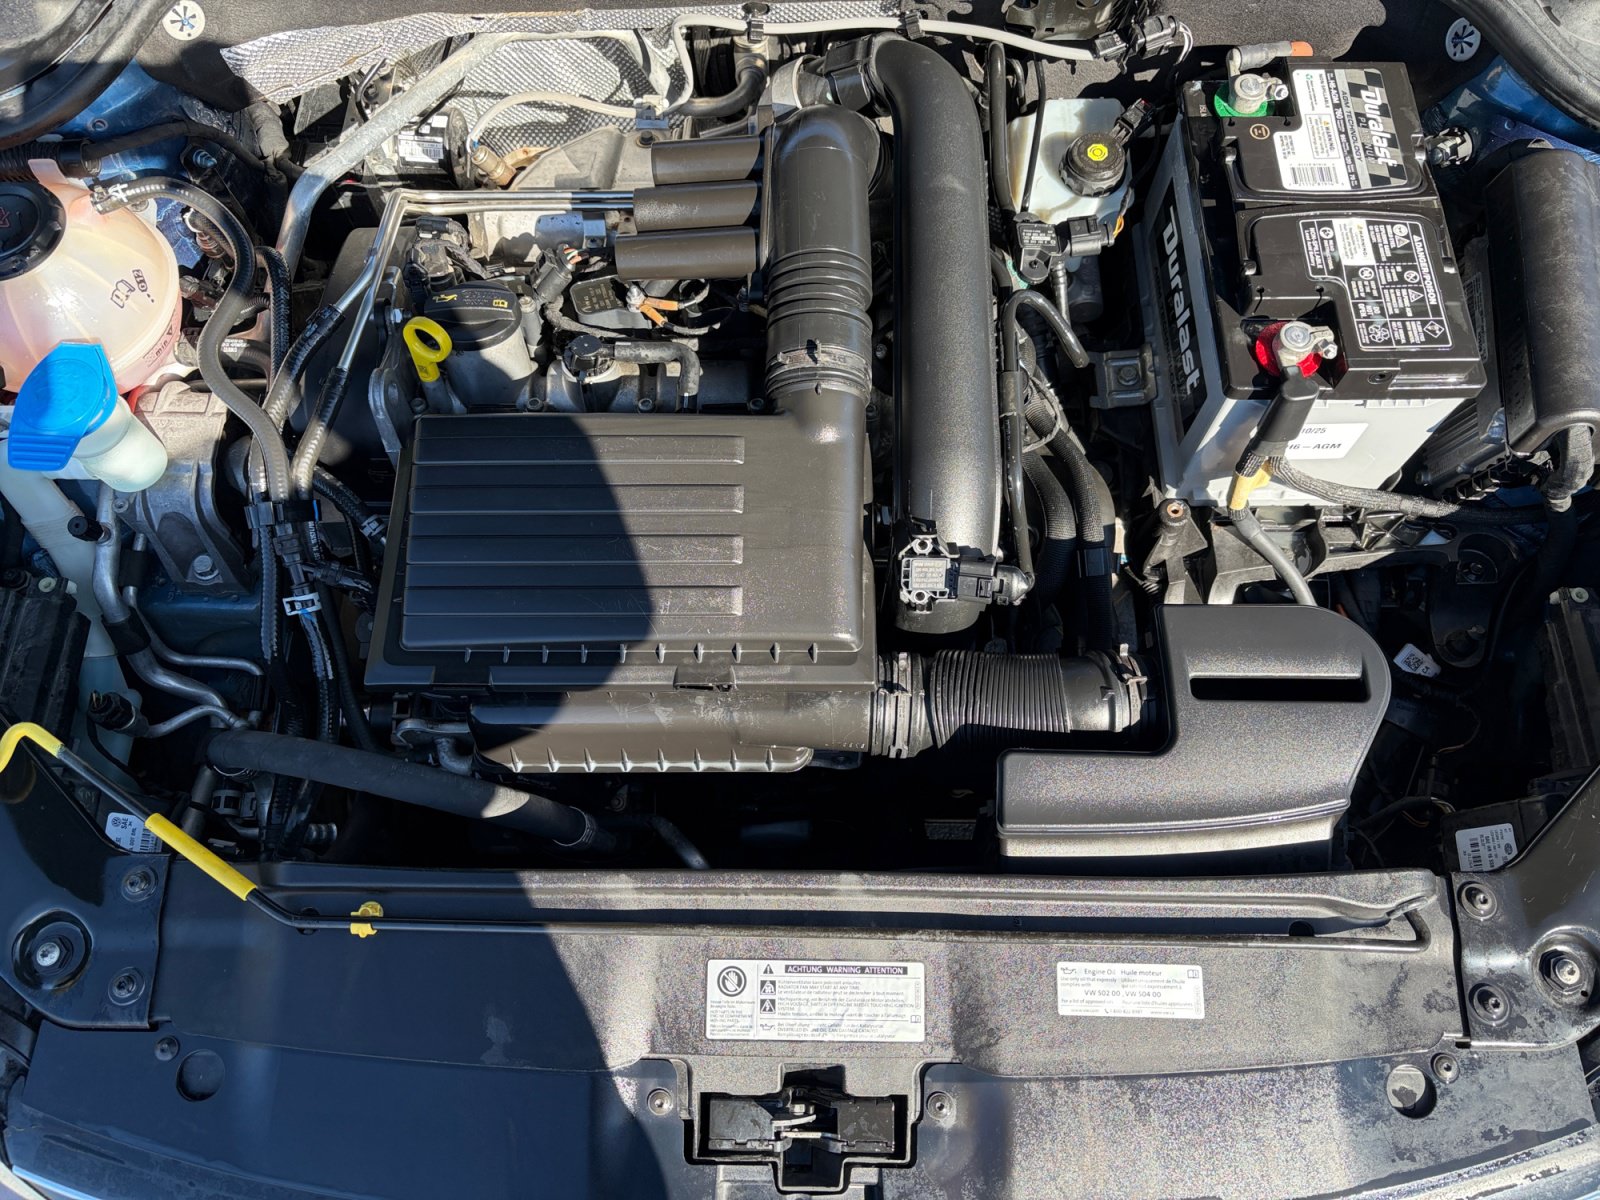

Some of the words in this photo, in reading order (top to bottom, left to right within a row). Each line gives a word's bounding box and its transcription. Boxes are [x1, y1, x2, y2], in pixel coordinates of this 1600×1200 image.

[1341, 90, 1351, 108] AGM
[1346, 110, 1363, 163] TECHNOLOGY
[1361, 87, 1398, 168] Duralast
[1415, 241, 1437, 305] DANGER/POISON
[1162, 205, 1200, 395] Duralast
[1358, 303, 1367, 318] OPEN.
[1366, 305, 1374, 315] NOT
[826, 966, 861, 974] WARNING
[1084, 968, 1106, 976] Engine
